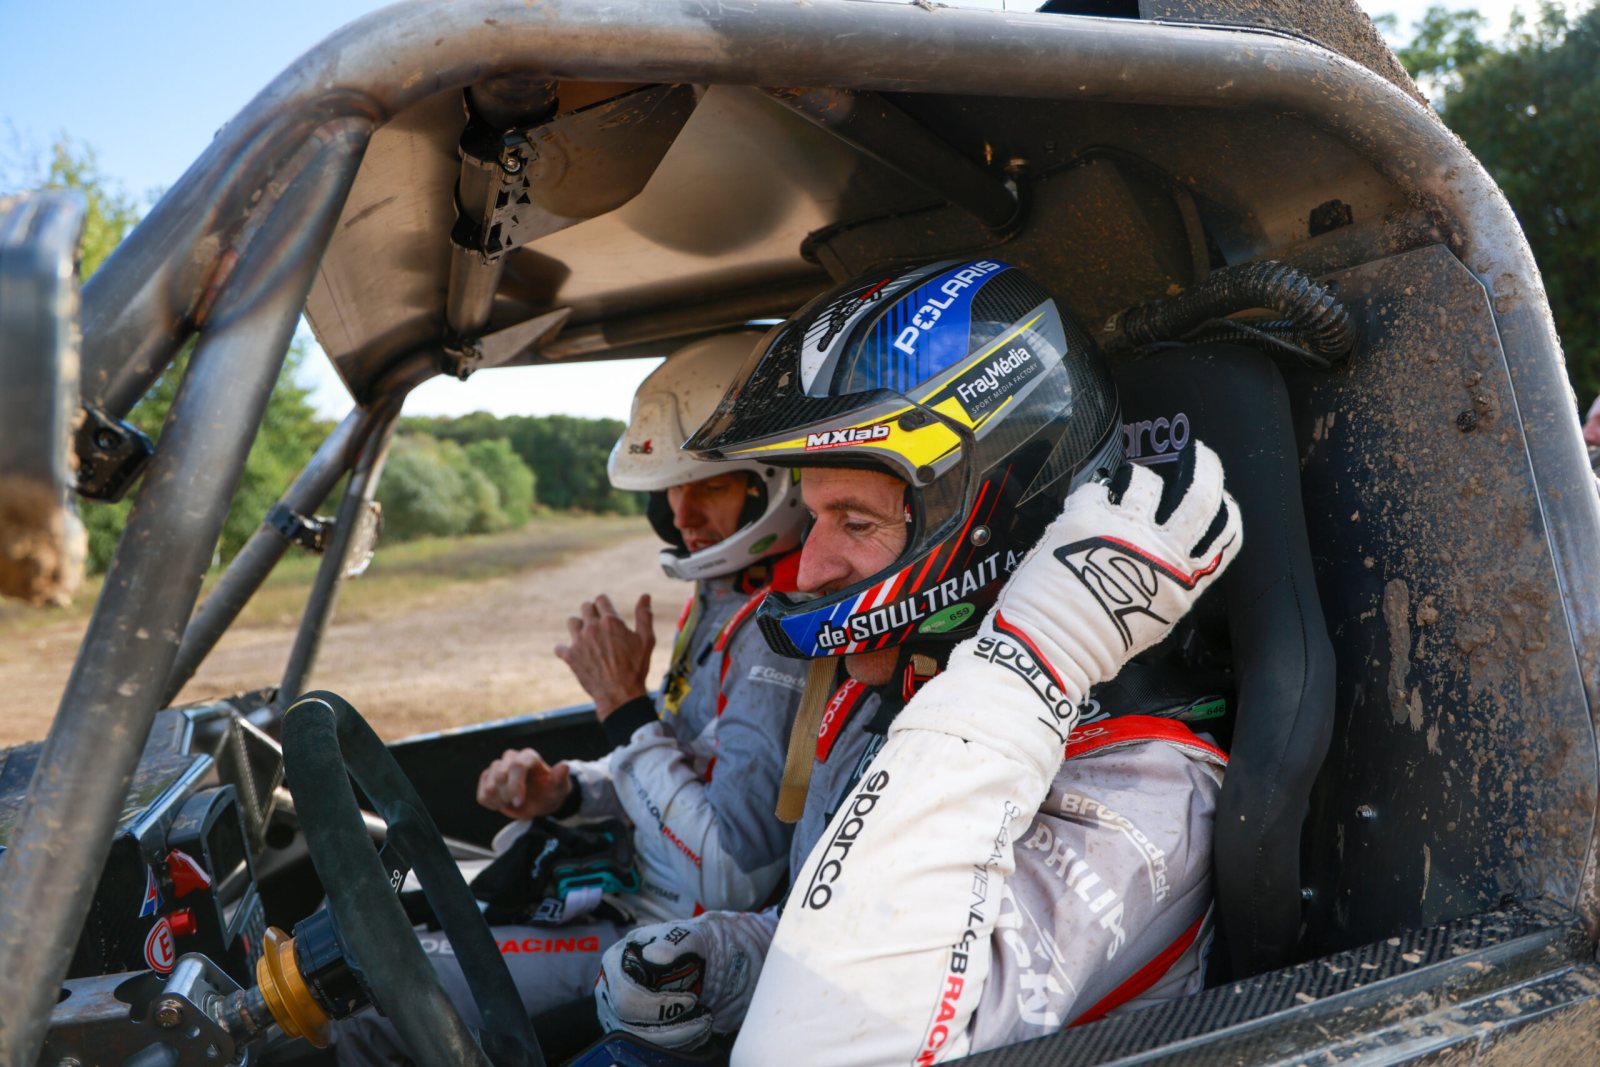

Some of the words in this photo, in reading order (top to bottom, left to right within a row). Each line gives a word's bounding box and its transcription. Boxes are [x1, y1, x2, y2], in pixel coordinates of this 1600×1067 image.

[894, 260, 1000, 355] POLARIS
[957, 347, 1031, 403] FrayMédia
[972, 396, 993, 414] SPORT
[993, 382, 1013, 398] MEDIA
[1013, 363, 1038, 383] FACTORY
[807, 425, 890, 447] MXlab
[818, 624, 847, 648] de
[851, 552, 1000, 641] SOULTRAIT
[949, 607, 970, 621] 659
[976, 635, 1073, 719] sparco
[808, 770, 890, 910] sparco
[1060, 793, 1171, 904] BFGoodrich
[1025, 823, 1127, 960] PHILIPS
[158, 931, 174, 963] E
[496, 936, 599, 955] ACING
